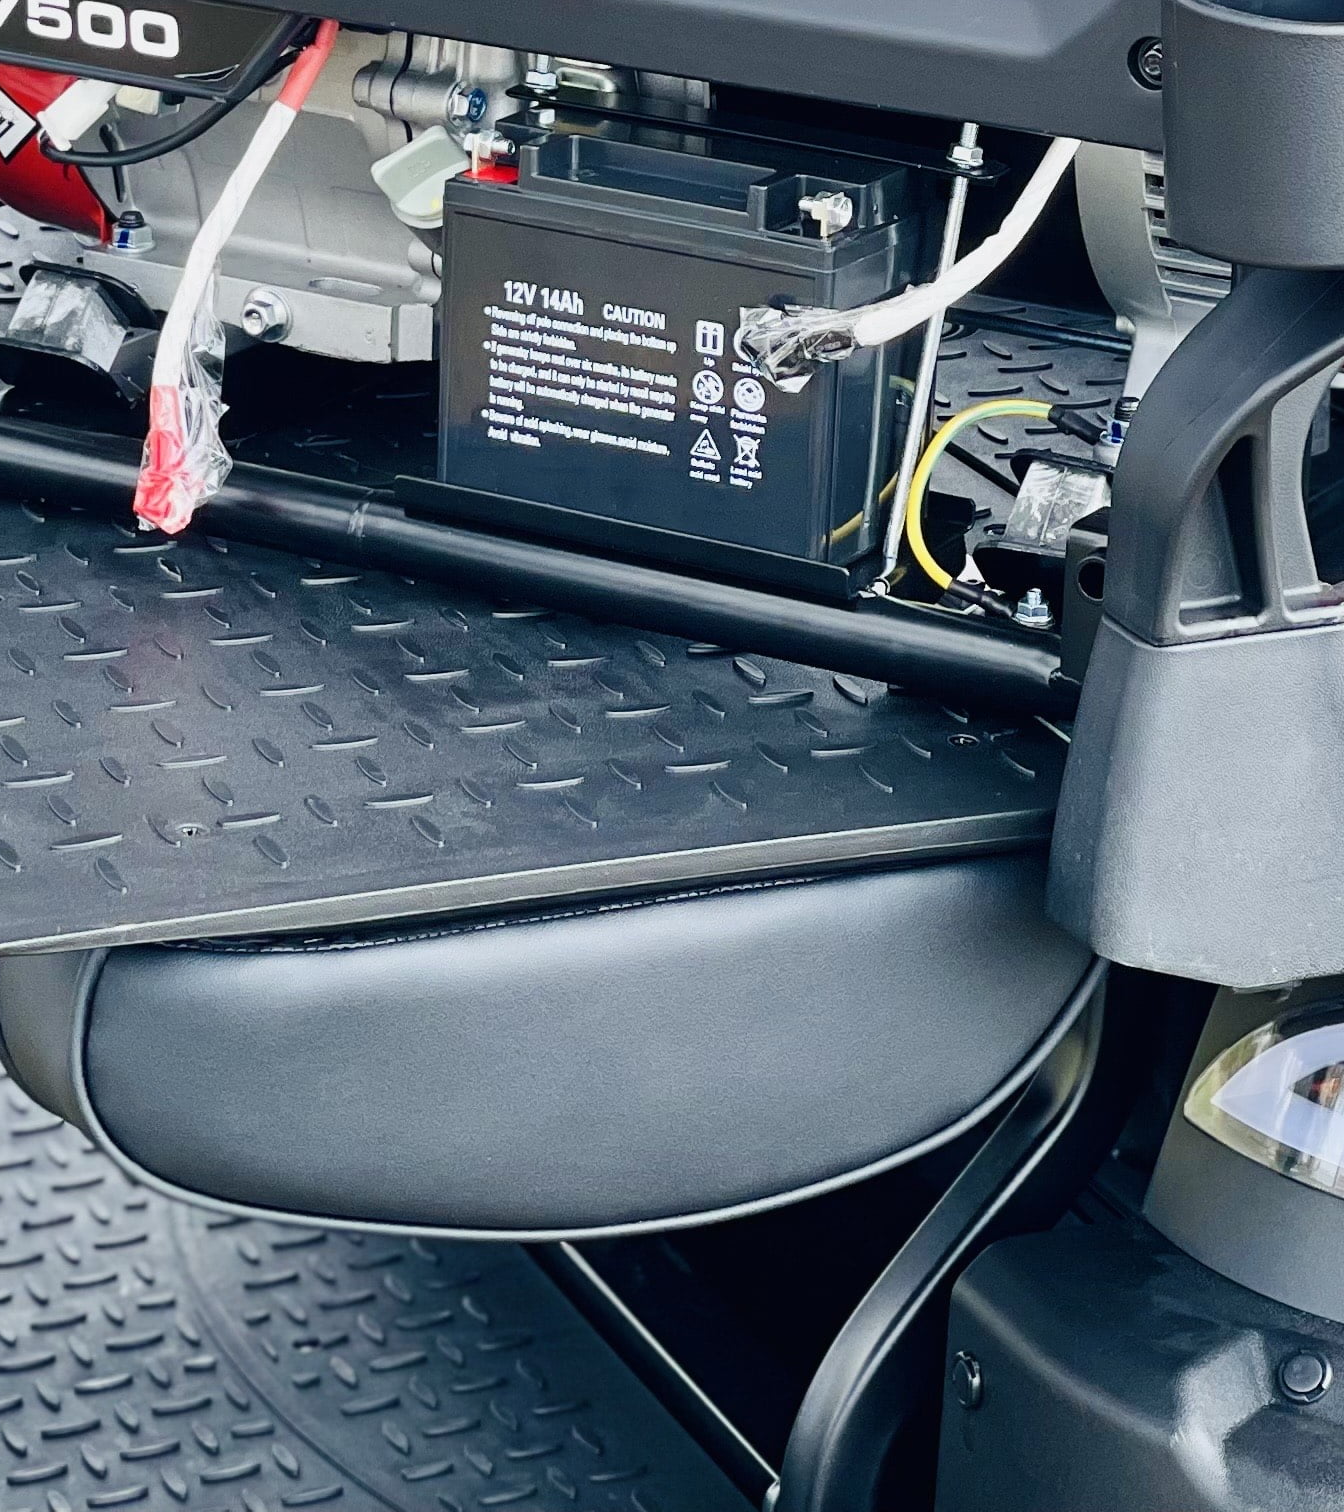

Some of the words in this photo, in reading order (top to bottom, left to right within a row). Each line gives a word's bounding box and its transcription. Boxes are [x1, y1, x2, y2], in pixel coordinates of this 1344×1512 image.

[503, 280, 537, 307] 12V
[540, 287, 584, 316] 14Ah
[602, 303, 667, 330] CAUTION
